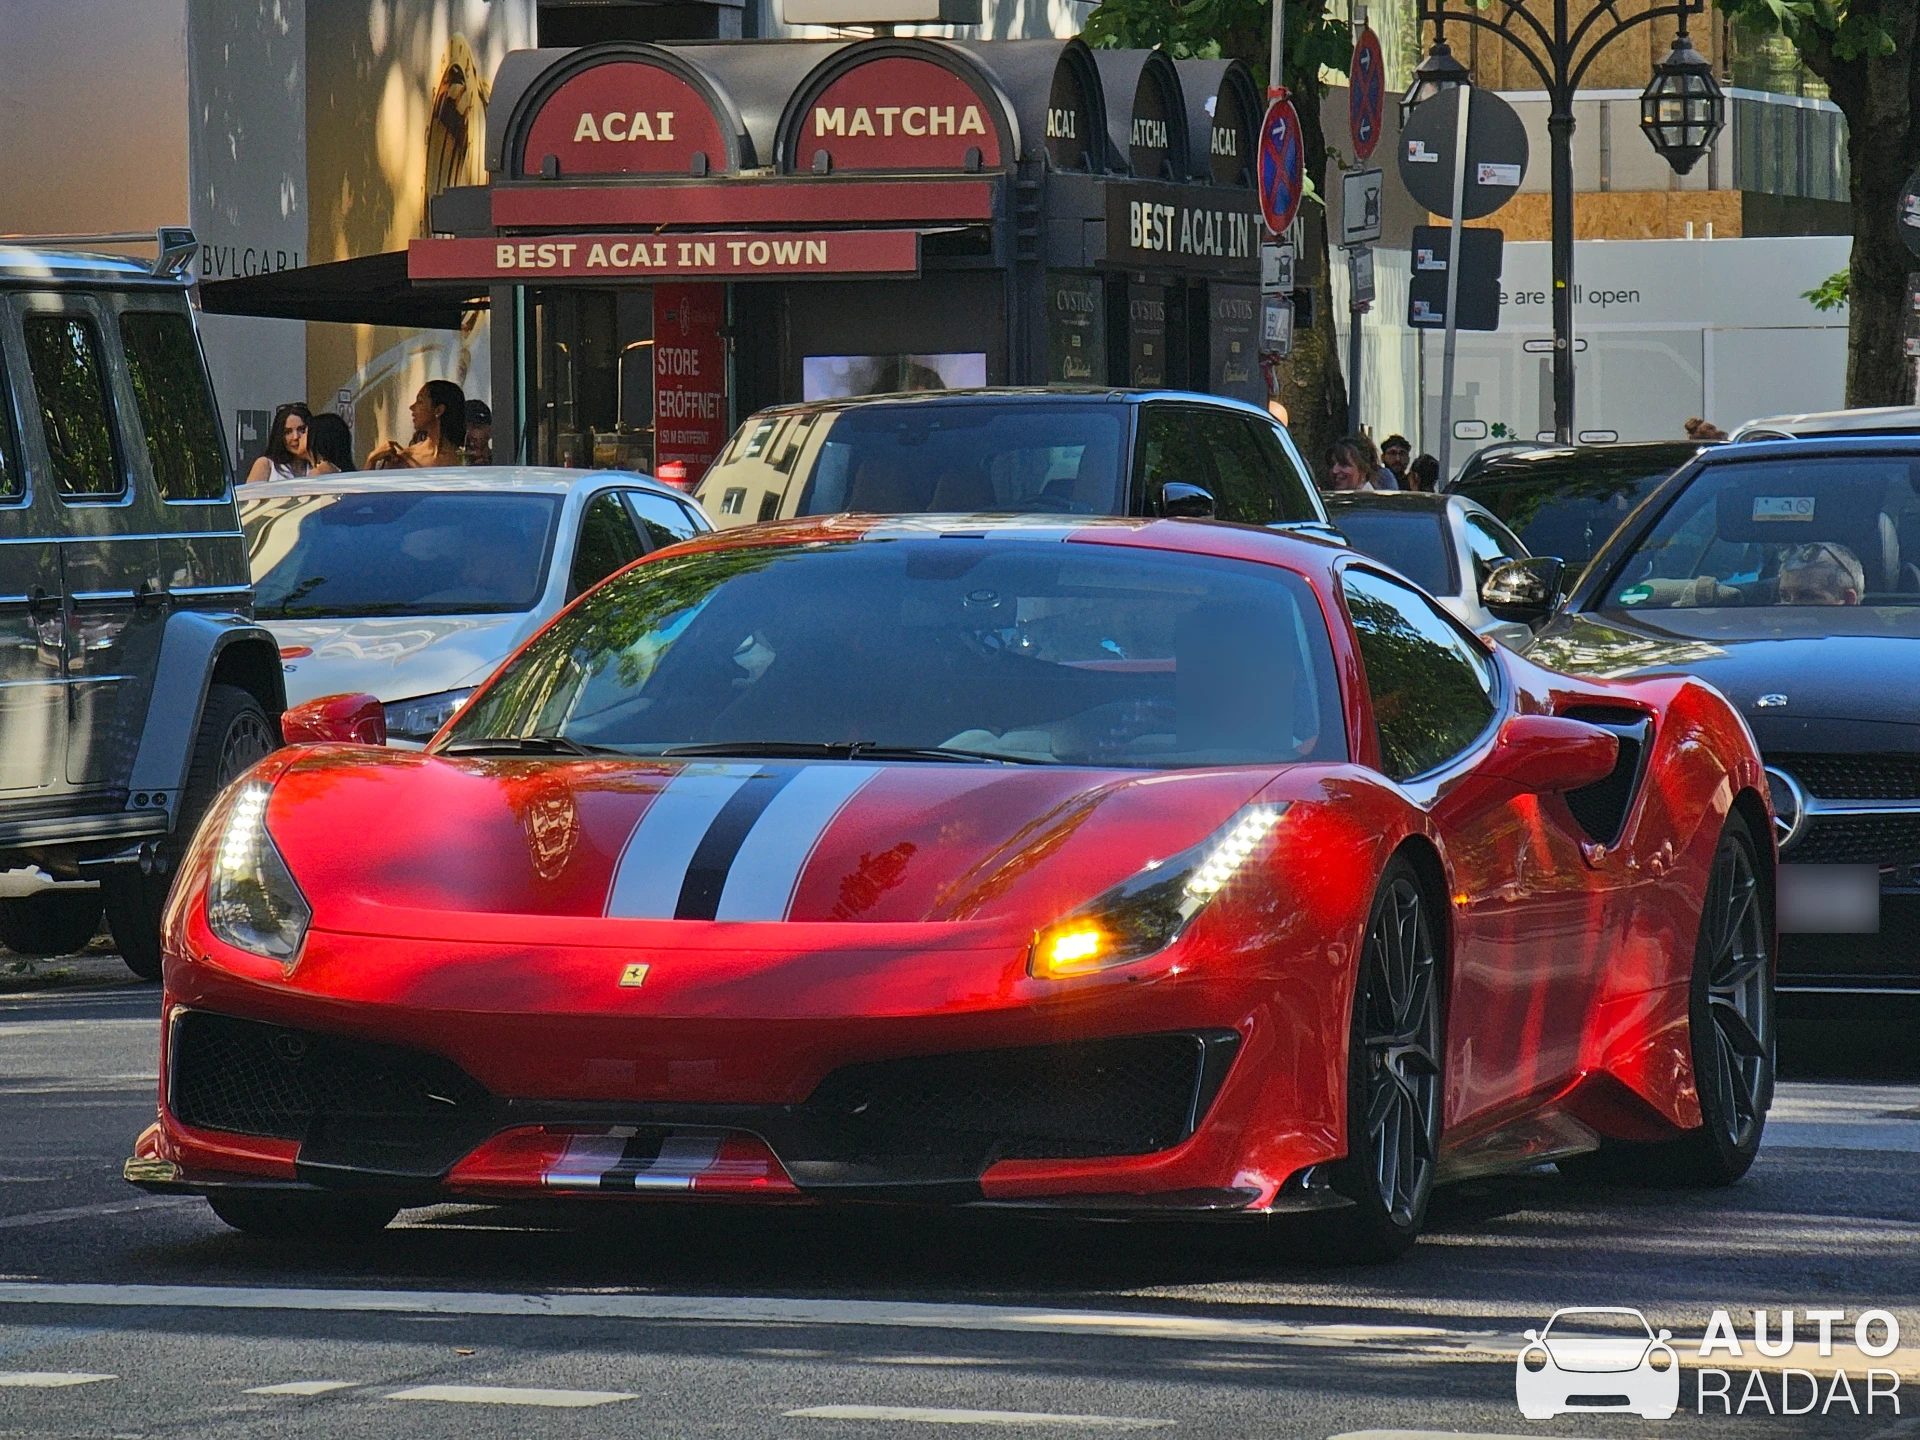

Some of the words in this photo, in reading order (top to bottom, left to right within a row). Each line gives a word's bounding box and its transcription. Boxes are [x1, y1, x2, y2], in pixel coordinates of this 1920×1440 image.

[574, 111, 675, 142] ACAI
[815, 105, 986, 137] MATCHA
[1046, 108, 1076, 139] ACAI
[1129, 118, 1168, 148] ATCHA
[1211, 126, 1237, 157] ACAI
[1130, 200, 1174, 252] BEST
[1180, 207, 1223, 256] ACAI
[1228, 211, 1249, 258] IN
[1253, 214, 1305, 260] TN
[202, 244, 299, 278] BVLGARI
[496, 244, 577, 270] BEST
[586, 242, 667, 269] ACAI
[677, 241, 716, 267] IN
[726, 239, 828, 266] TOWN
[1514, 290, 1546, 305] are
[1589, 289, 1640, 309] open
[658, 347, 700, 376] STORE
[658, 384, 721, 419] ERÖFFNET
